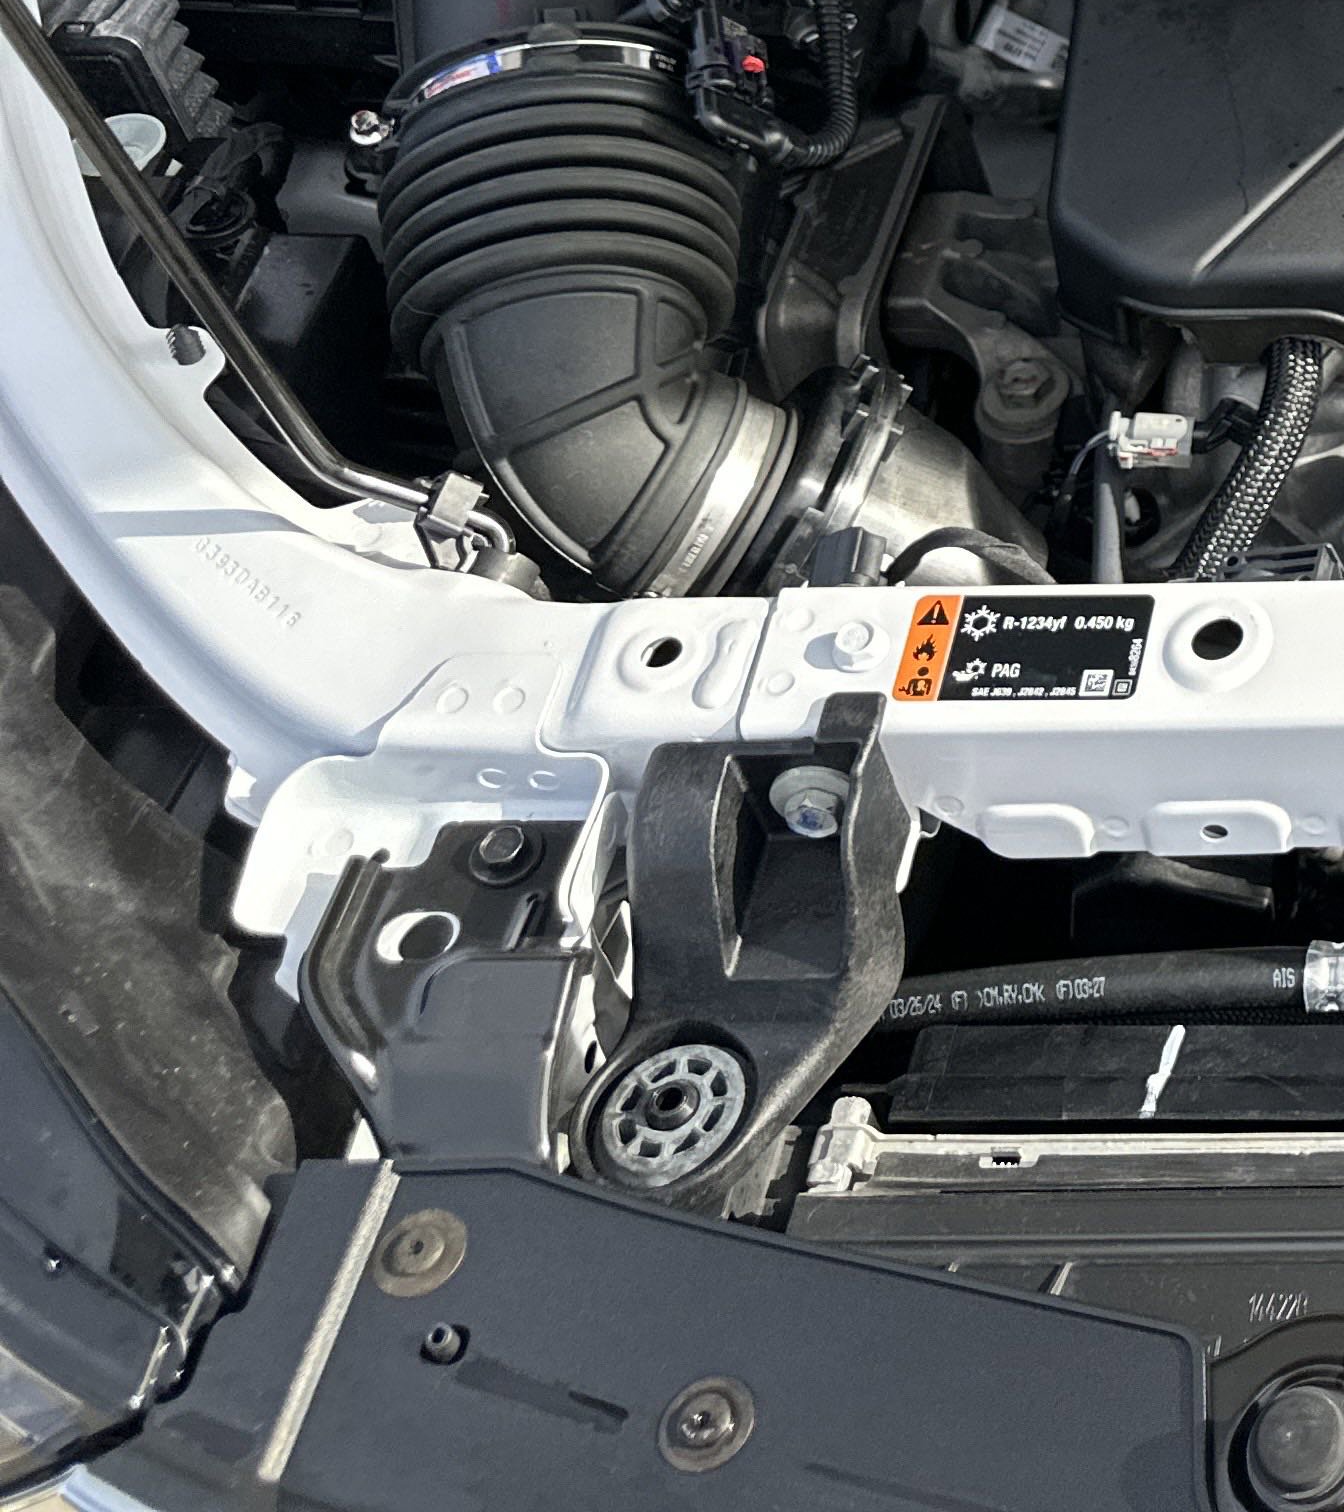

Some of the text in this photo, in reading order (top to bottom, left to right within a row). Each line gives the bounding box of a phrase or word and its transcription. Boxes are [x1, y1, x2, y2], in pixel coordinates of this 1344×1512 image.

[1002, 615, 1135, 632] R-1234yf 0.450 kg
[991, 662, 1022, 679] PAG
